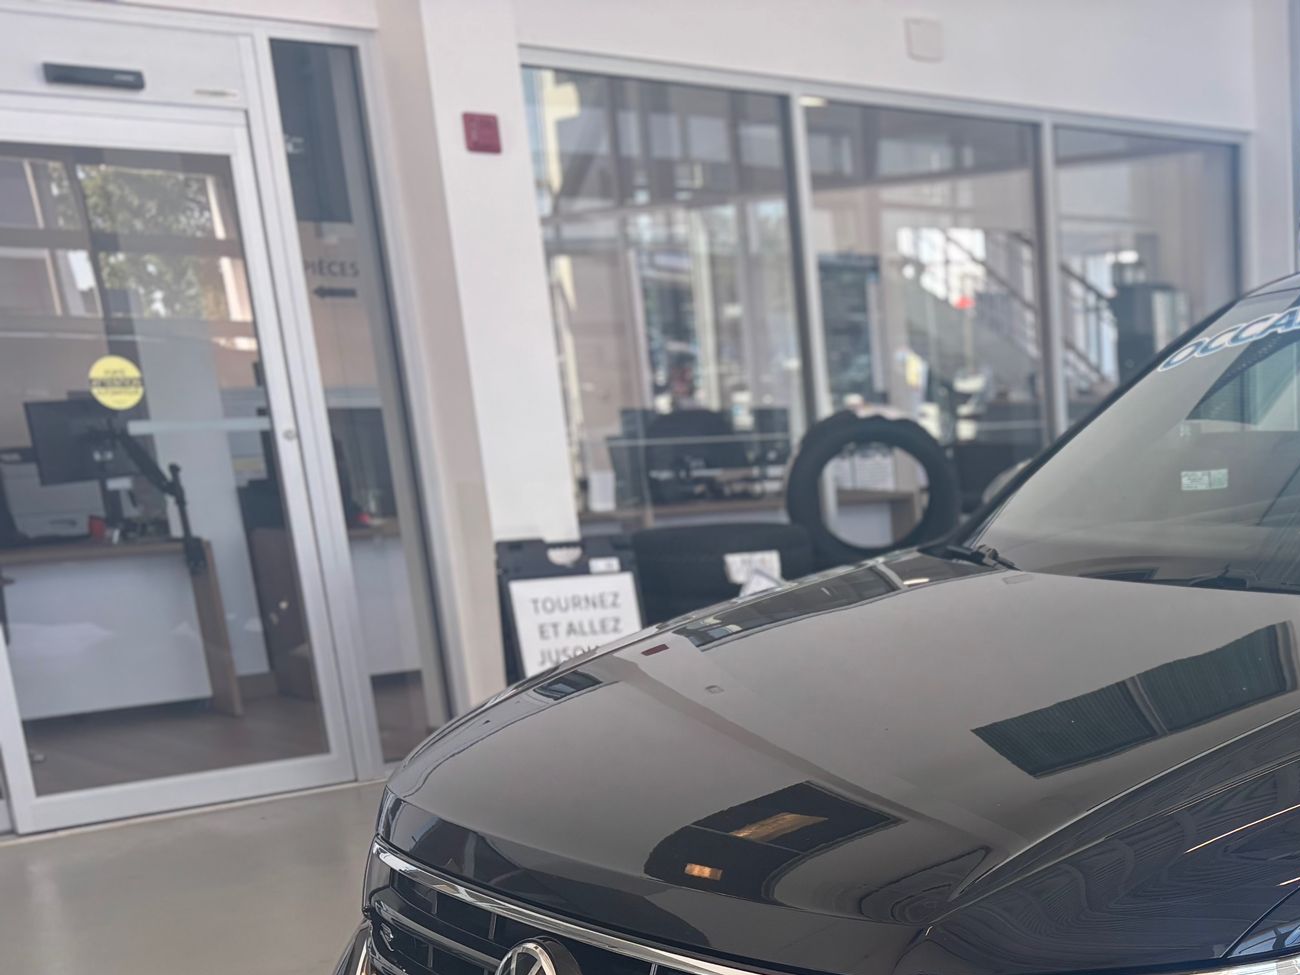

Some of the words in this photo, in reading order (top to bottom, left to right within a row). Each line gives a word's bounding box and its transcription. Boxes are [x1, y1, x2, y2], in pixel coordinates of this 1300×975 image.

[530, 592, 622, 616] TOURNEZ
[538, 622, 560, 641] ET
[566, 617, 622, 639] ALLEZ
